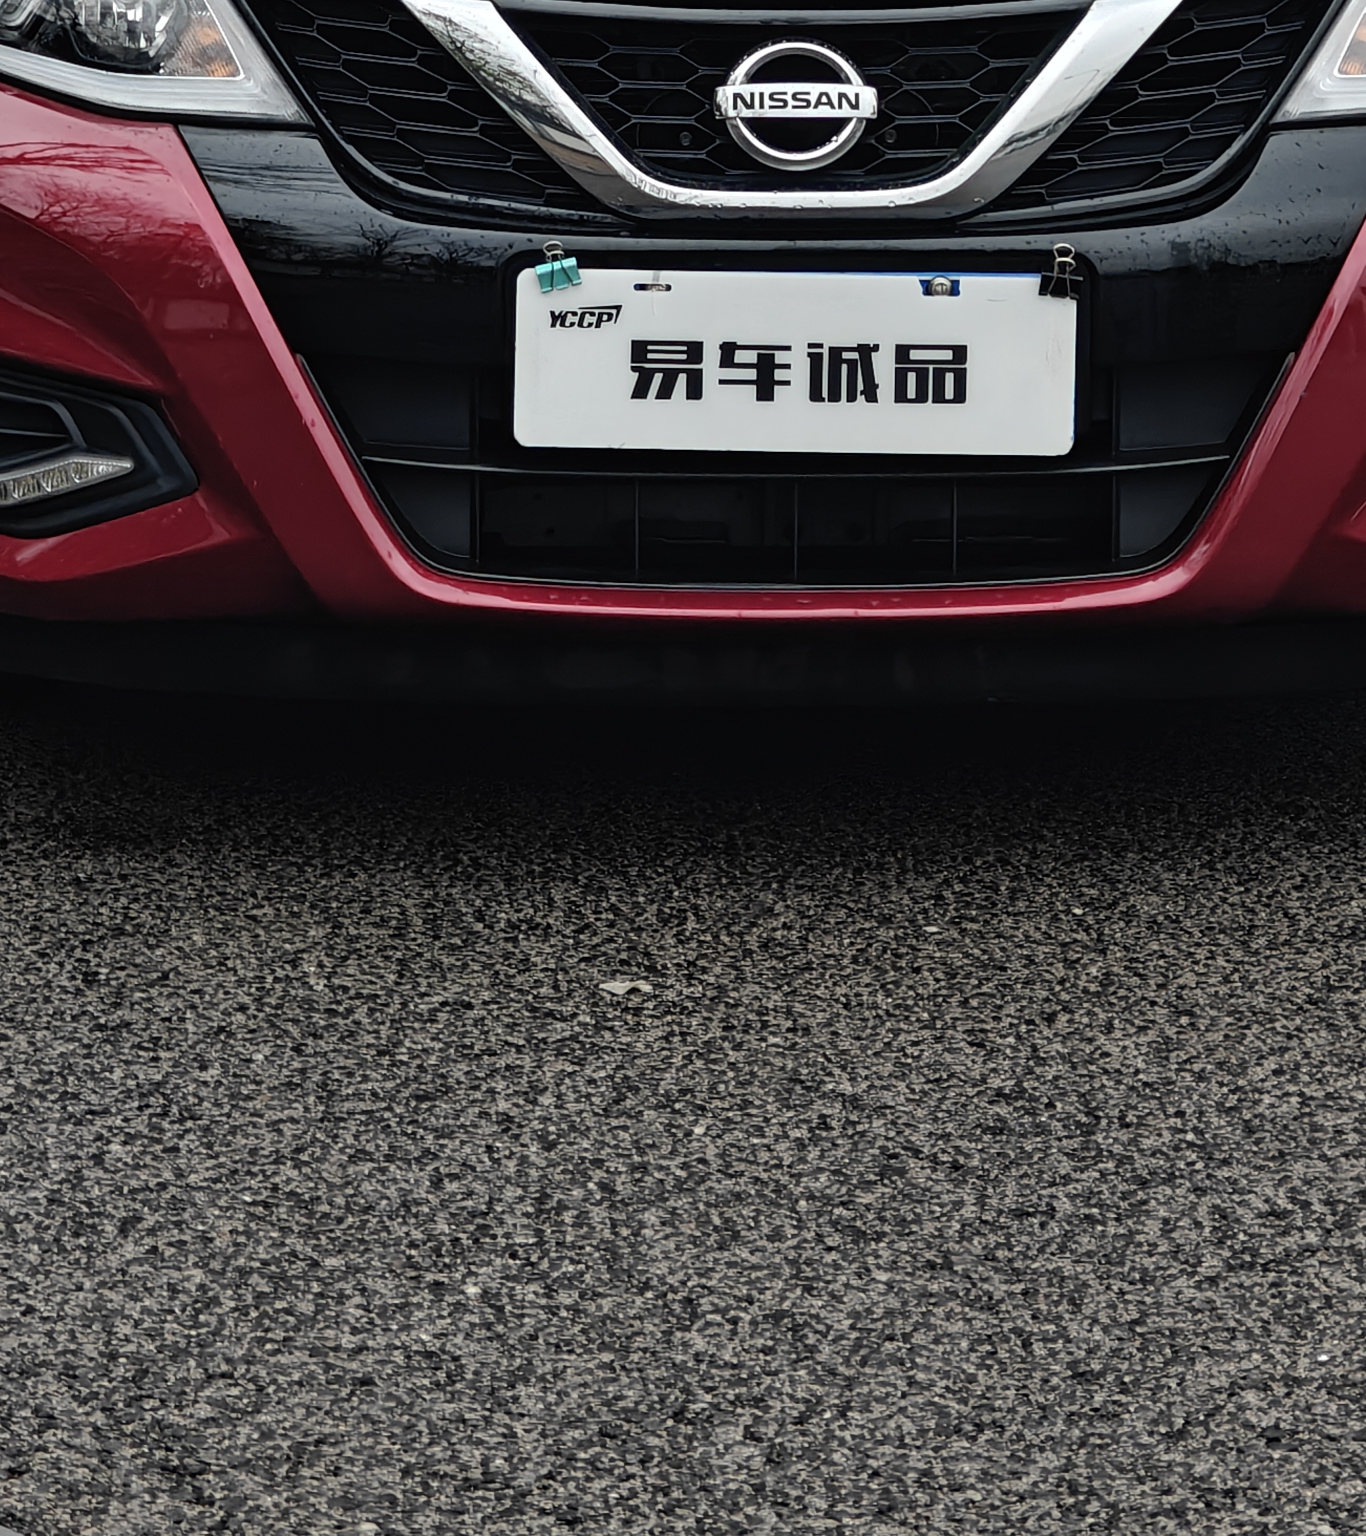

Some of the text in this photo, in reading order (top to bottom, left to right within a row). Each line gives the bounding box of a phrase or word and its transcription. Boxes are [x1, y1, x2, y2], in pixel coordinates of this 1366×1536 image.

[733, 91, 860, 111] NISSAN
[549, 308, 617, 329] YCCP
[630, 339, 968, 404] 易车诚品
